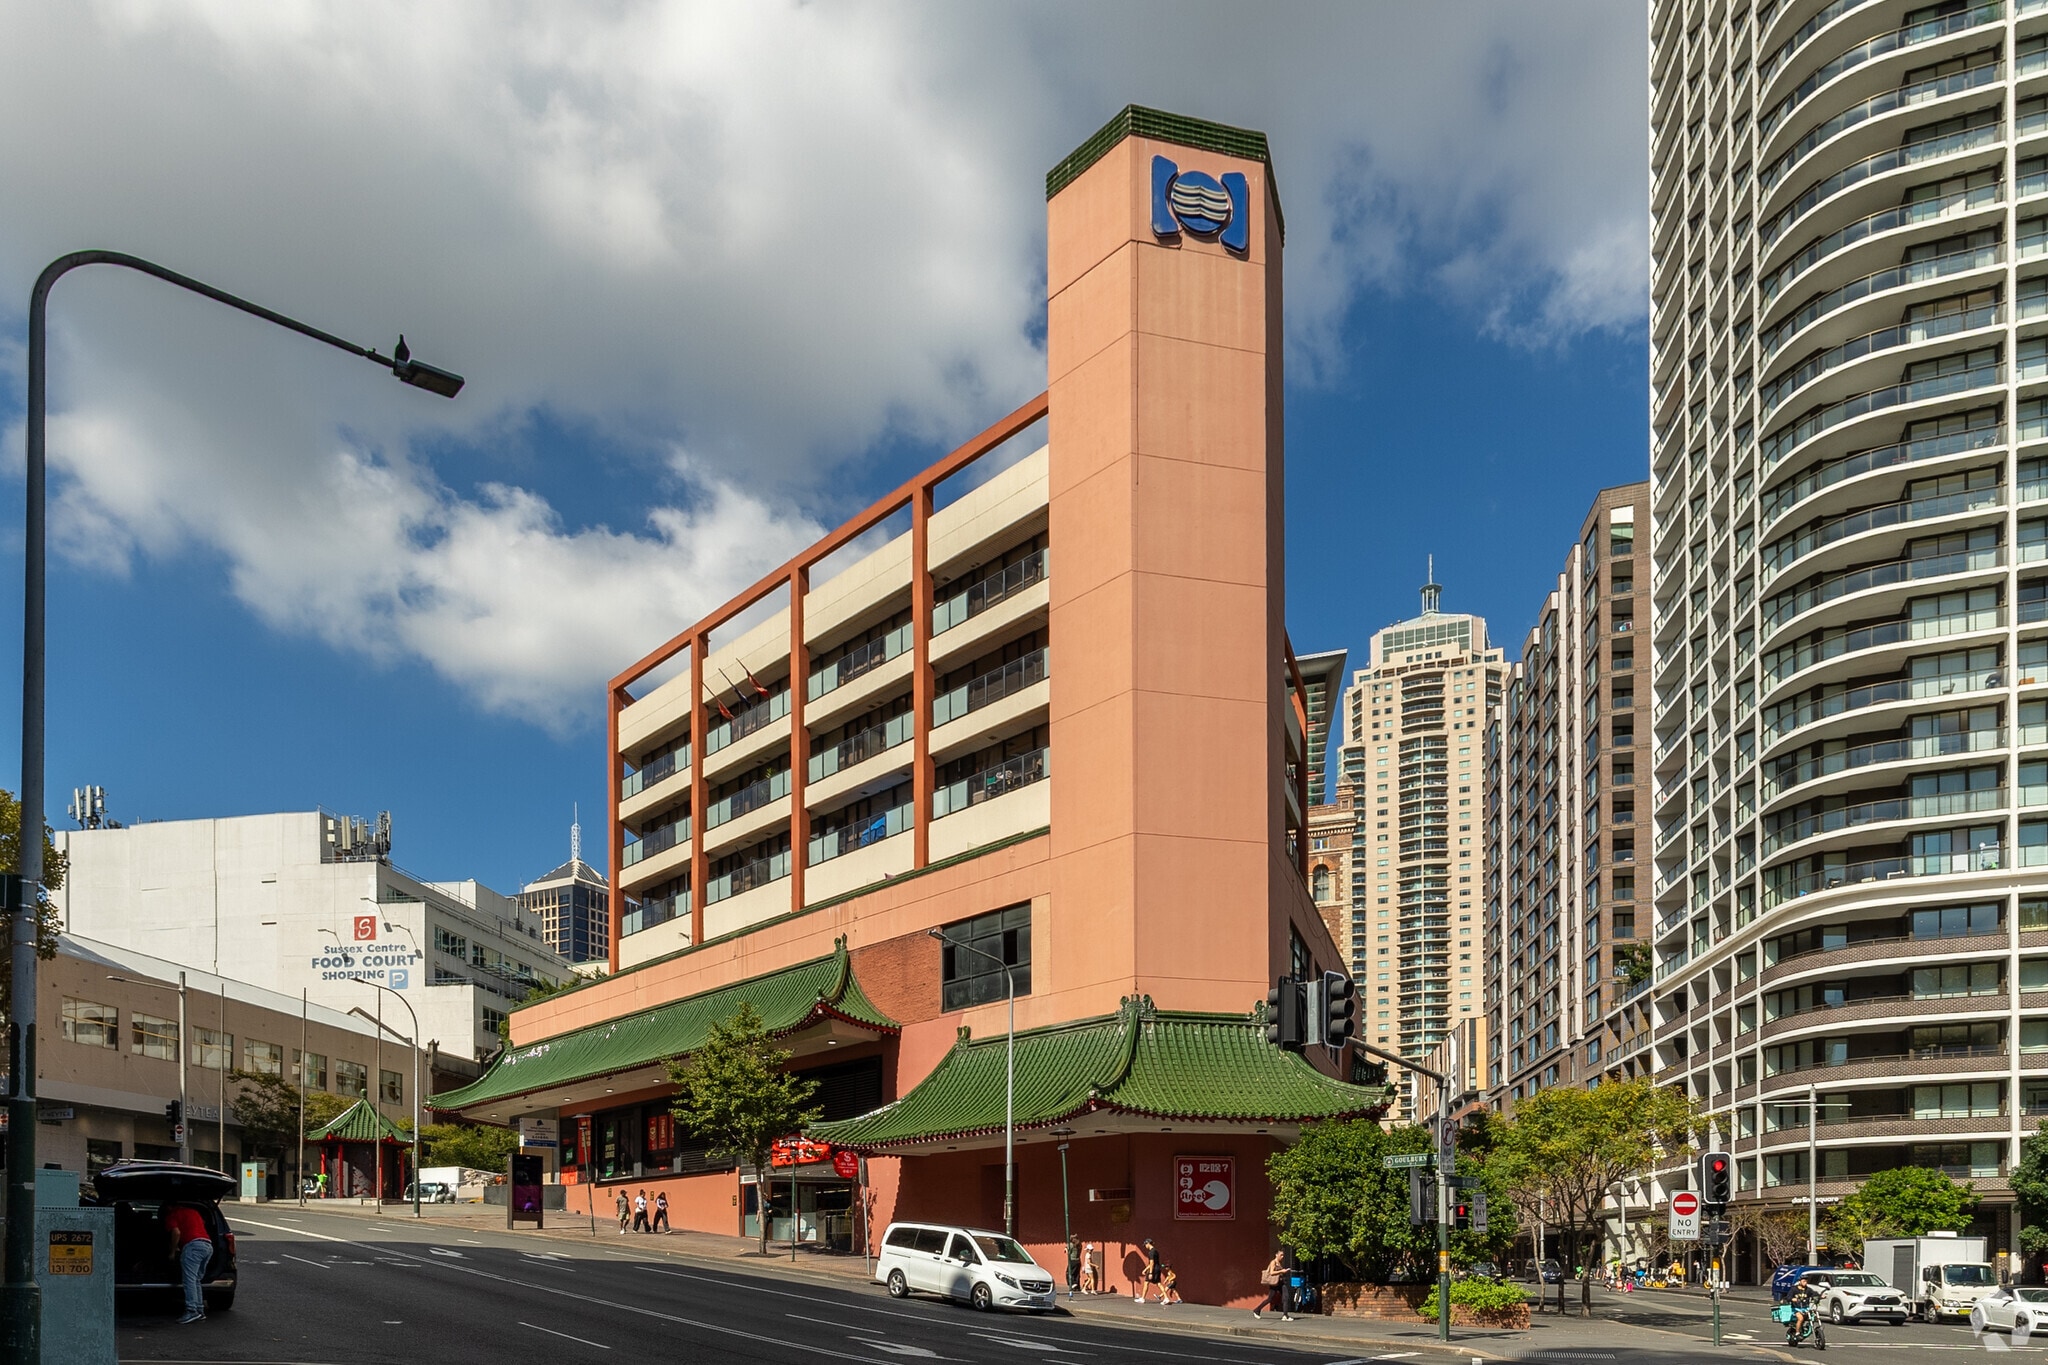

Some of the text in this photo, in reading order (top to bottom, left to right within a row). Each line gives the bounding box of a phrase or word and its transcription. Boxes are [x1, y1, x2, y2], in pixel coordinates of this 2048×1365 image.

[324, 943, 407, 954] Sussex Centre
[311, 954, 417, 969] FOOD COURT
[322, 970, 385, 980] SHOPPING
[392, 972, 405, 987] P
[185, 1104, 219, 1119] EYTEA
[1443, 1148, 1452, 1156] NO
[1394, 1155, 1427, 1164] GOULBURN
[1475, 1196, 1485, 1206] ONE
[1791, 1196, 1811, 1204] darlin
[1475, 1208, 1485, 1217] WAY
[1677, 1218, 1692, 1227] NO
[51, 1233, 92, 1242] UPS 2672
[51, 1264, 90, 1273] 131 700
